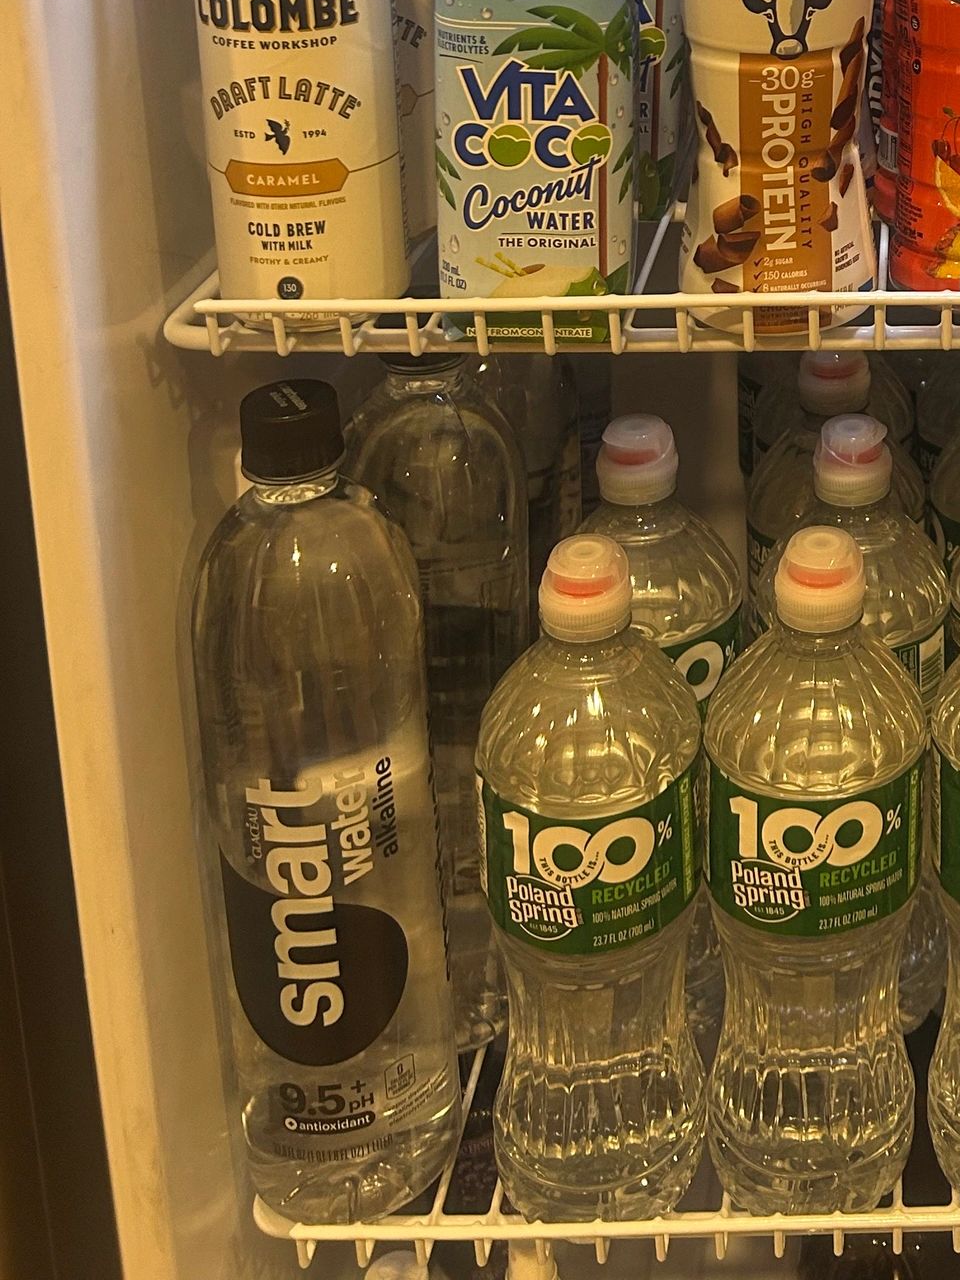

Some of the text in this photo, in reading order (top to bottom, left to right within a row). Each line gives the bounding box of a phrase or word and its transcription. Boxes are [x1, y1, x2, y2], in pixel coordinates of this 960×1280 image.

[212, 35, 338, 50] COFFEE WORKSHOP
[456, 56, 595, 123] VITA
[760, 66, 815, 92] 30g
[210, 75, 361, 121] DRAFT LATTE
[234, 127, 327, 140] ESTD 1994
[451, 121, 613, 170] COCO
[246, 173, 321, 186] CARAMEL
[761, 94, 797, 252] PROTEIN
[796, 92, 813, 251] HIGH QUALITY
[463, 157, 601, 232] Coconut
[248, 220, 327, 237] COLD BREW
[527, 210, 596, 231] WATER
[261, 239, 313, 251] WITH MILK
[498, 236, 597, 249] THE ORIGINAL
[249, 256, 281, 265] FROTHY
[292, 254, 329, 265] CREAMY
[764, 256, 774, 267] 2g
[283, 283, 297, 293] 130
[763, 269, 808, 280] 150 CALORIES
[375, 756, 398, 858] alkaline
[330, 764, 375, 886] water
[729, 795, 901, 870] 100%
[502, 811, 673, 875] 100%
[539, 857, 554, 877] THIS
[555, 871, 590, 884] BOTTLE
[592, 860, 672, 905] RECYCLED
[731, 860, 803, 889] Poland
[819, 853, 897, 888] RECYCLED
[245, 777, 346, 1027] smart
[507, 876, 574, 907] Poland
[733, 883, 806, 910] Spring
[509, 900, 579, 928] Spring
[278, 1082, 346, 1116] 9.5
[349, 1091, 375, 1113] pH
[299, 1114, 371, 1132] antioxidant
